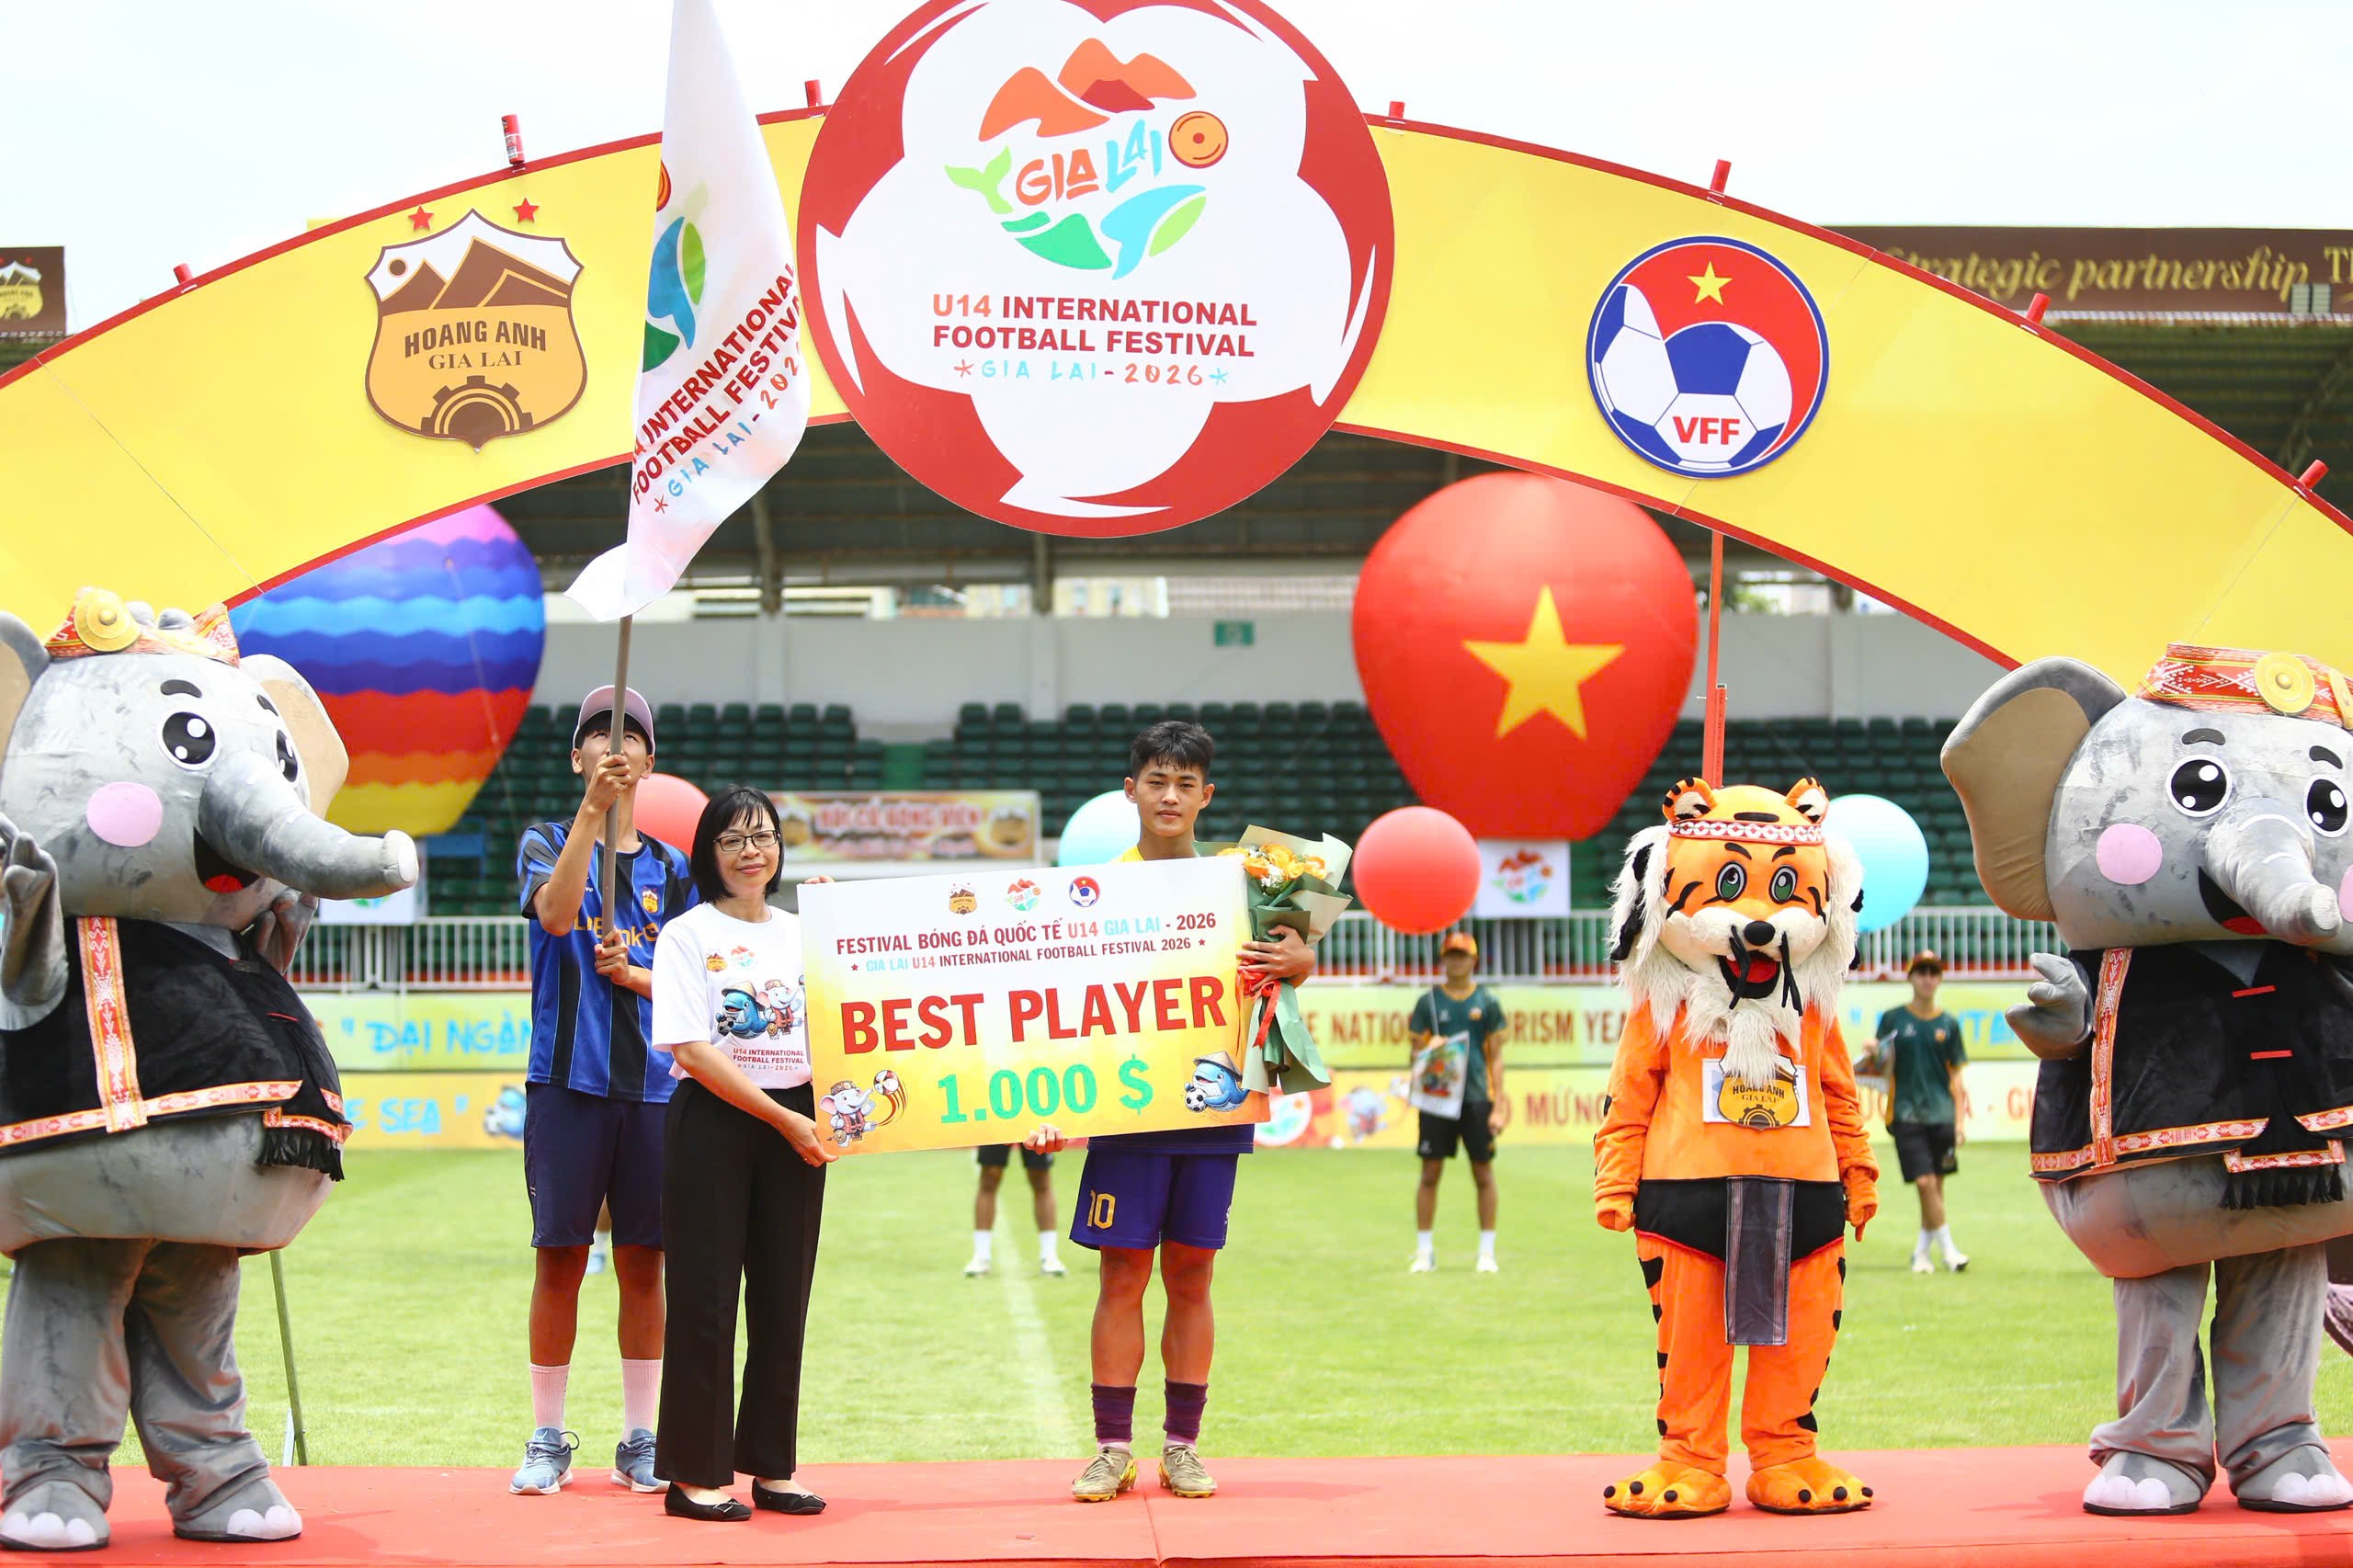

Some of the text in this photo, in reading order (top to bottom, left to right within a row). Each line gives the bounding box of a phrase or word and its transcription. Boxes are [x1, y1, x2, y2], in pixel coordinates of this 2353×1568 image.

[1016, 119, 1162, 205] GIA LAI
[1884, 246, 2063, 301] rategic
[2067, 244, 2309, 302] partnership
[932, 294, 1258, 326] U14 INTERNATIONAL
[404, 320, 546, 358] HOANG ANH
[933, 325, 1256, 358] FOOTBALL FESTIVAL
[428, 350, 523, 370] GIA LAI
[982, 359, 1030, 379] GIA
[668, 457, 710, 497] GIA
[760, 341, 800, 410] 202
[1673, 415, 1741, 445] VFF
[632, 404, 731, 506] FOOTBALL
[836, 935, 912, 955] FESTIVAL
[917, 928, 962, 949] BÓNG
[967, 925, 989, 946] ĐÁ
[994, 919, 1037, 946] QUỐC
[1041, 917, 1063, 940] TẾ
[1067, 921, 1098, 938] U14
[1104, 918, 1130, 936] GIA
[1135, 916, 1160, 934] LAI
[1176, 912, 1216, 931] 2026
[866, 937, 1191, 972] GIA LAI U14 INTERNATIONAL FOOTBALL FESTIVAL 2026
[840, 975, 1227, 1055] BEST PLAYER
[1331, 1011, 1414, 1046] NATIO
[1506, 1010, 1574, 1044] RISM
[733, 1054, 770, 1063] FOOTBALL
[748, 1049, 804, 1057] INTERNATIONAL
[938, 1053, 1154, 1124] 1.000 $
[380, 1097, 442, 1134] SEA
[1086, 1189, 1116, 1230] 10
